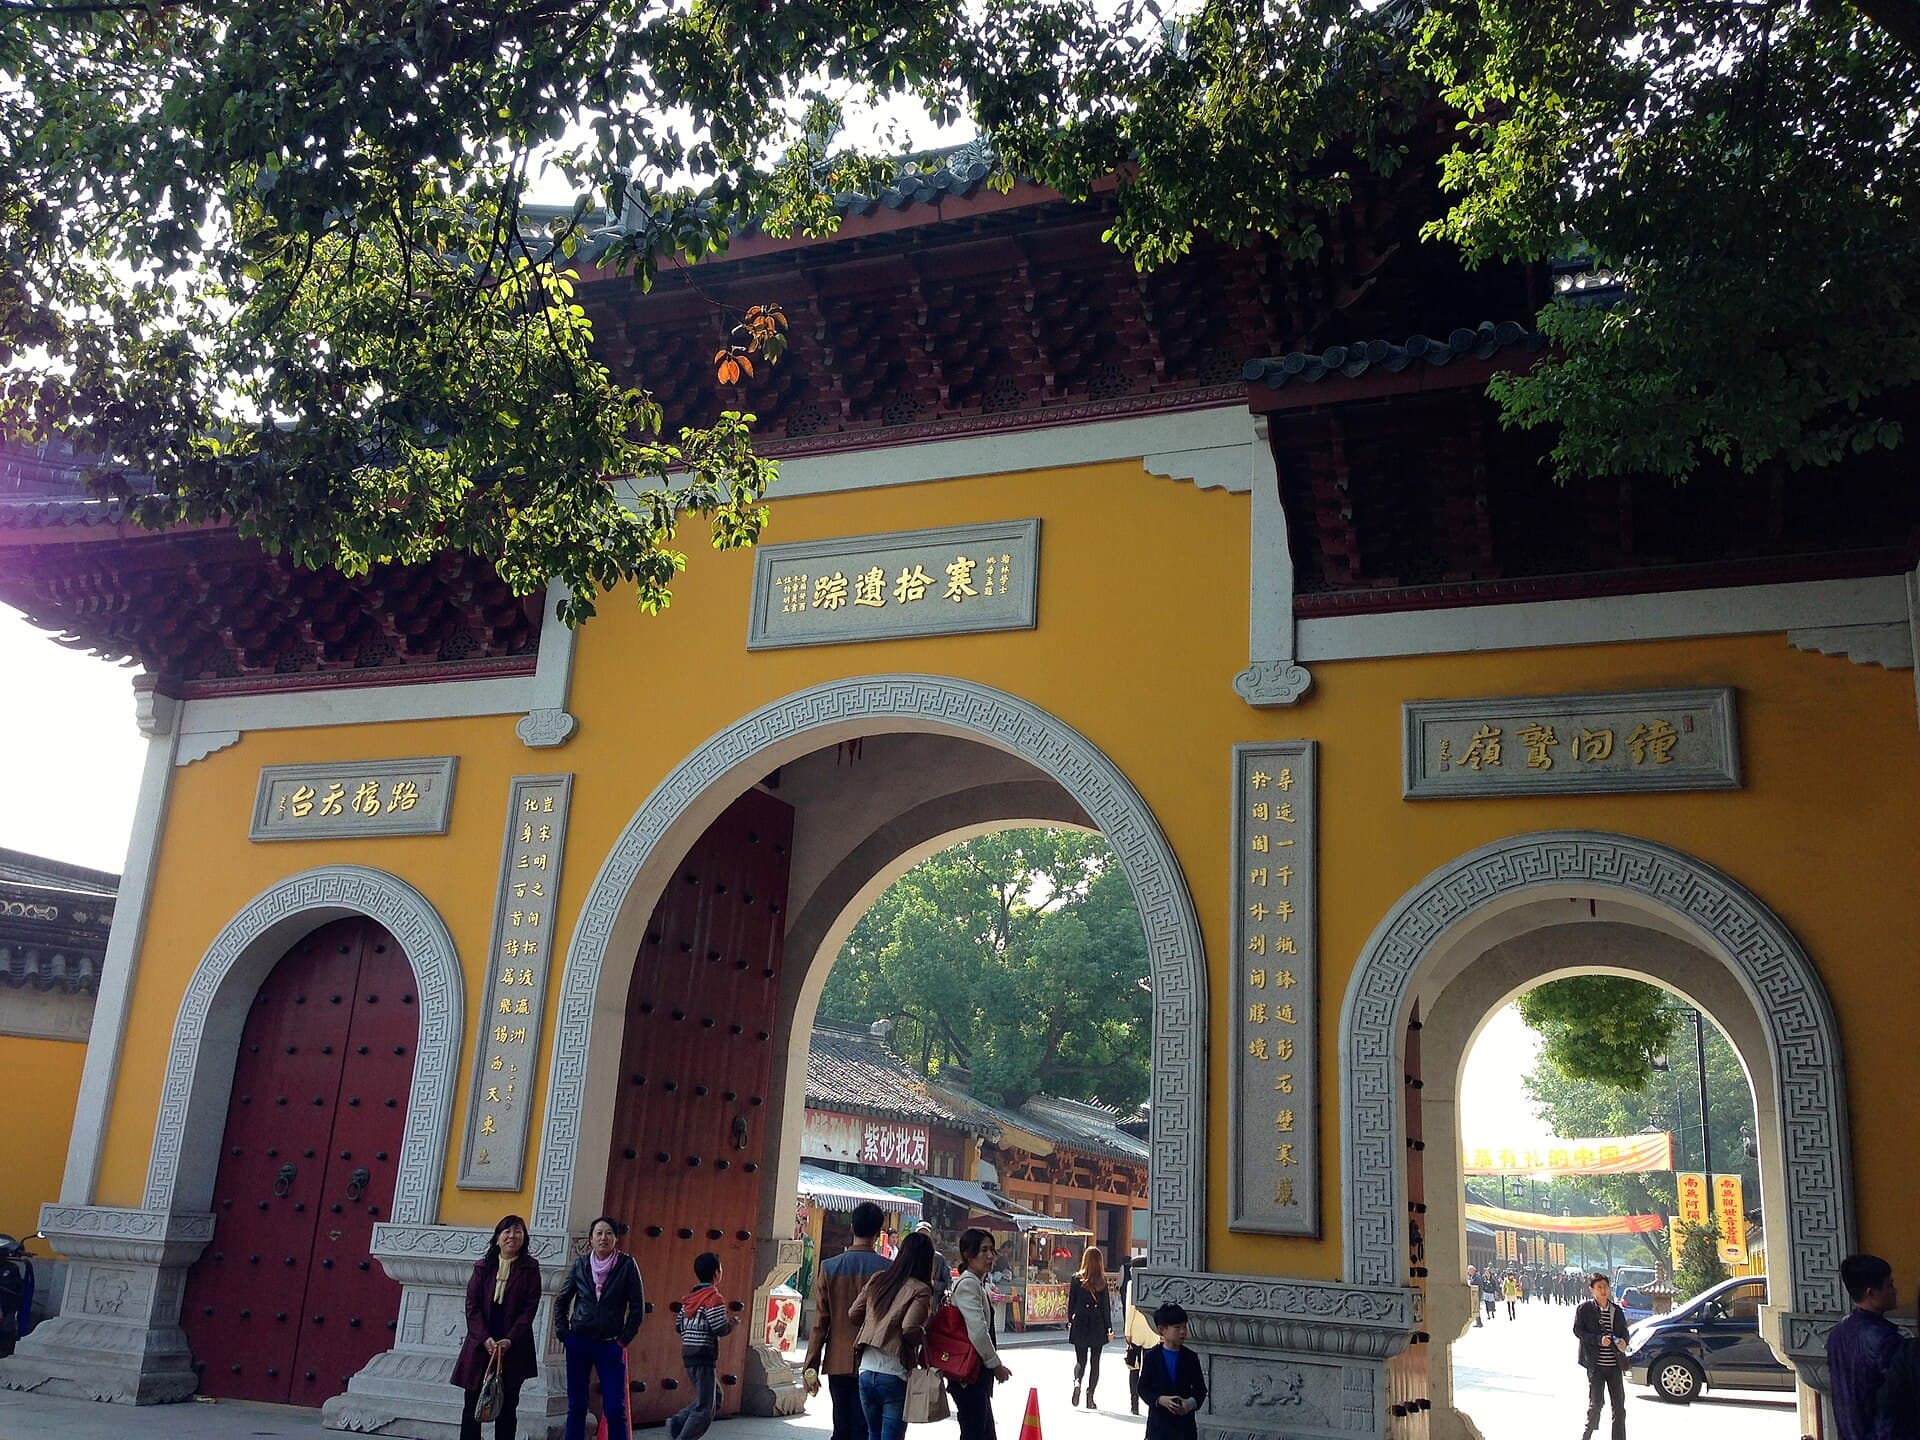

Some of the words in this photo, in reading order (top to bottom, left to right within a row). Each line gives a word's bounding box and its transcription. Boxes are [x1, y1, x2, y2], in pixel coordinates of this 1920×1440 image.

[864, 1121, 926, 1167] 紫砂批发
[1463, 1145, 1644, 1168] 恭有礼的中国人
